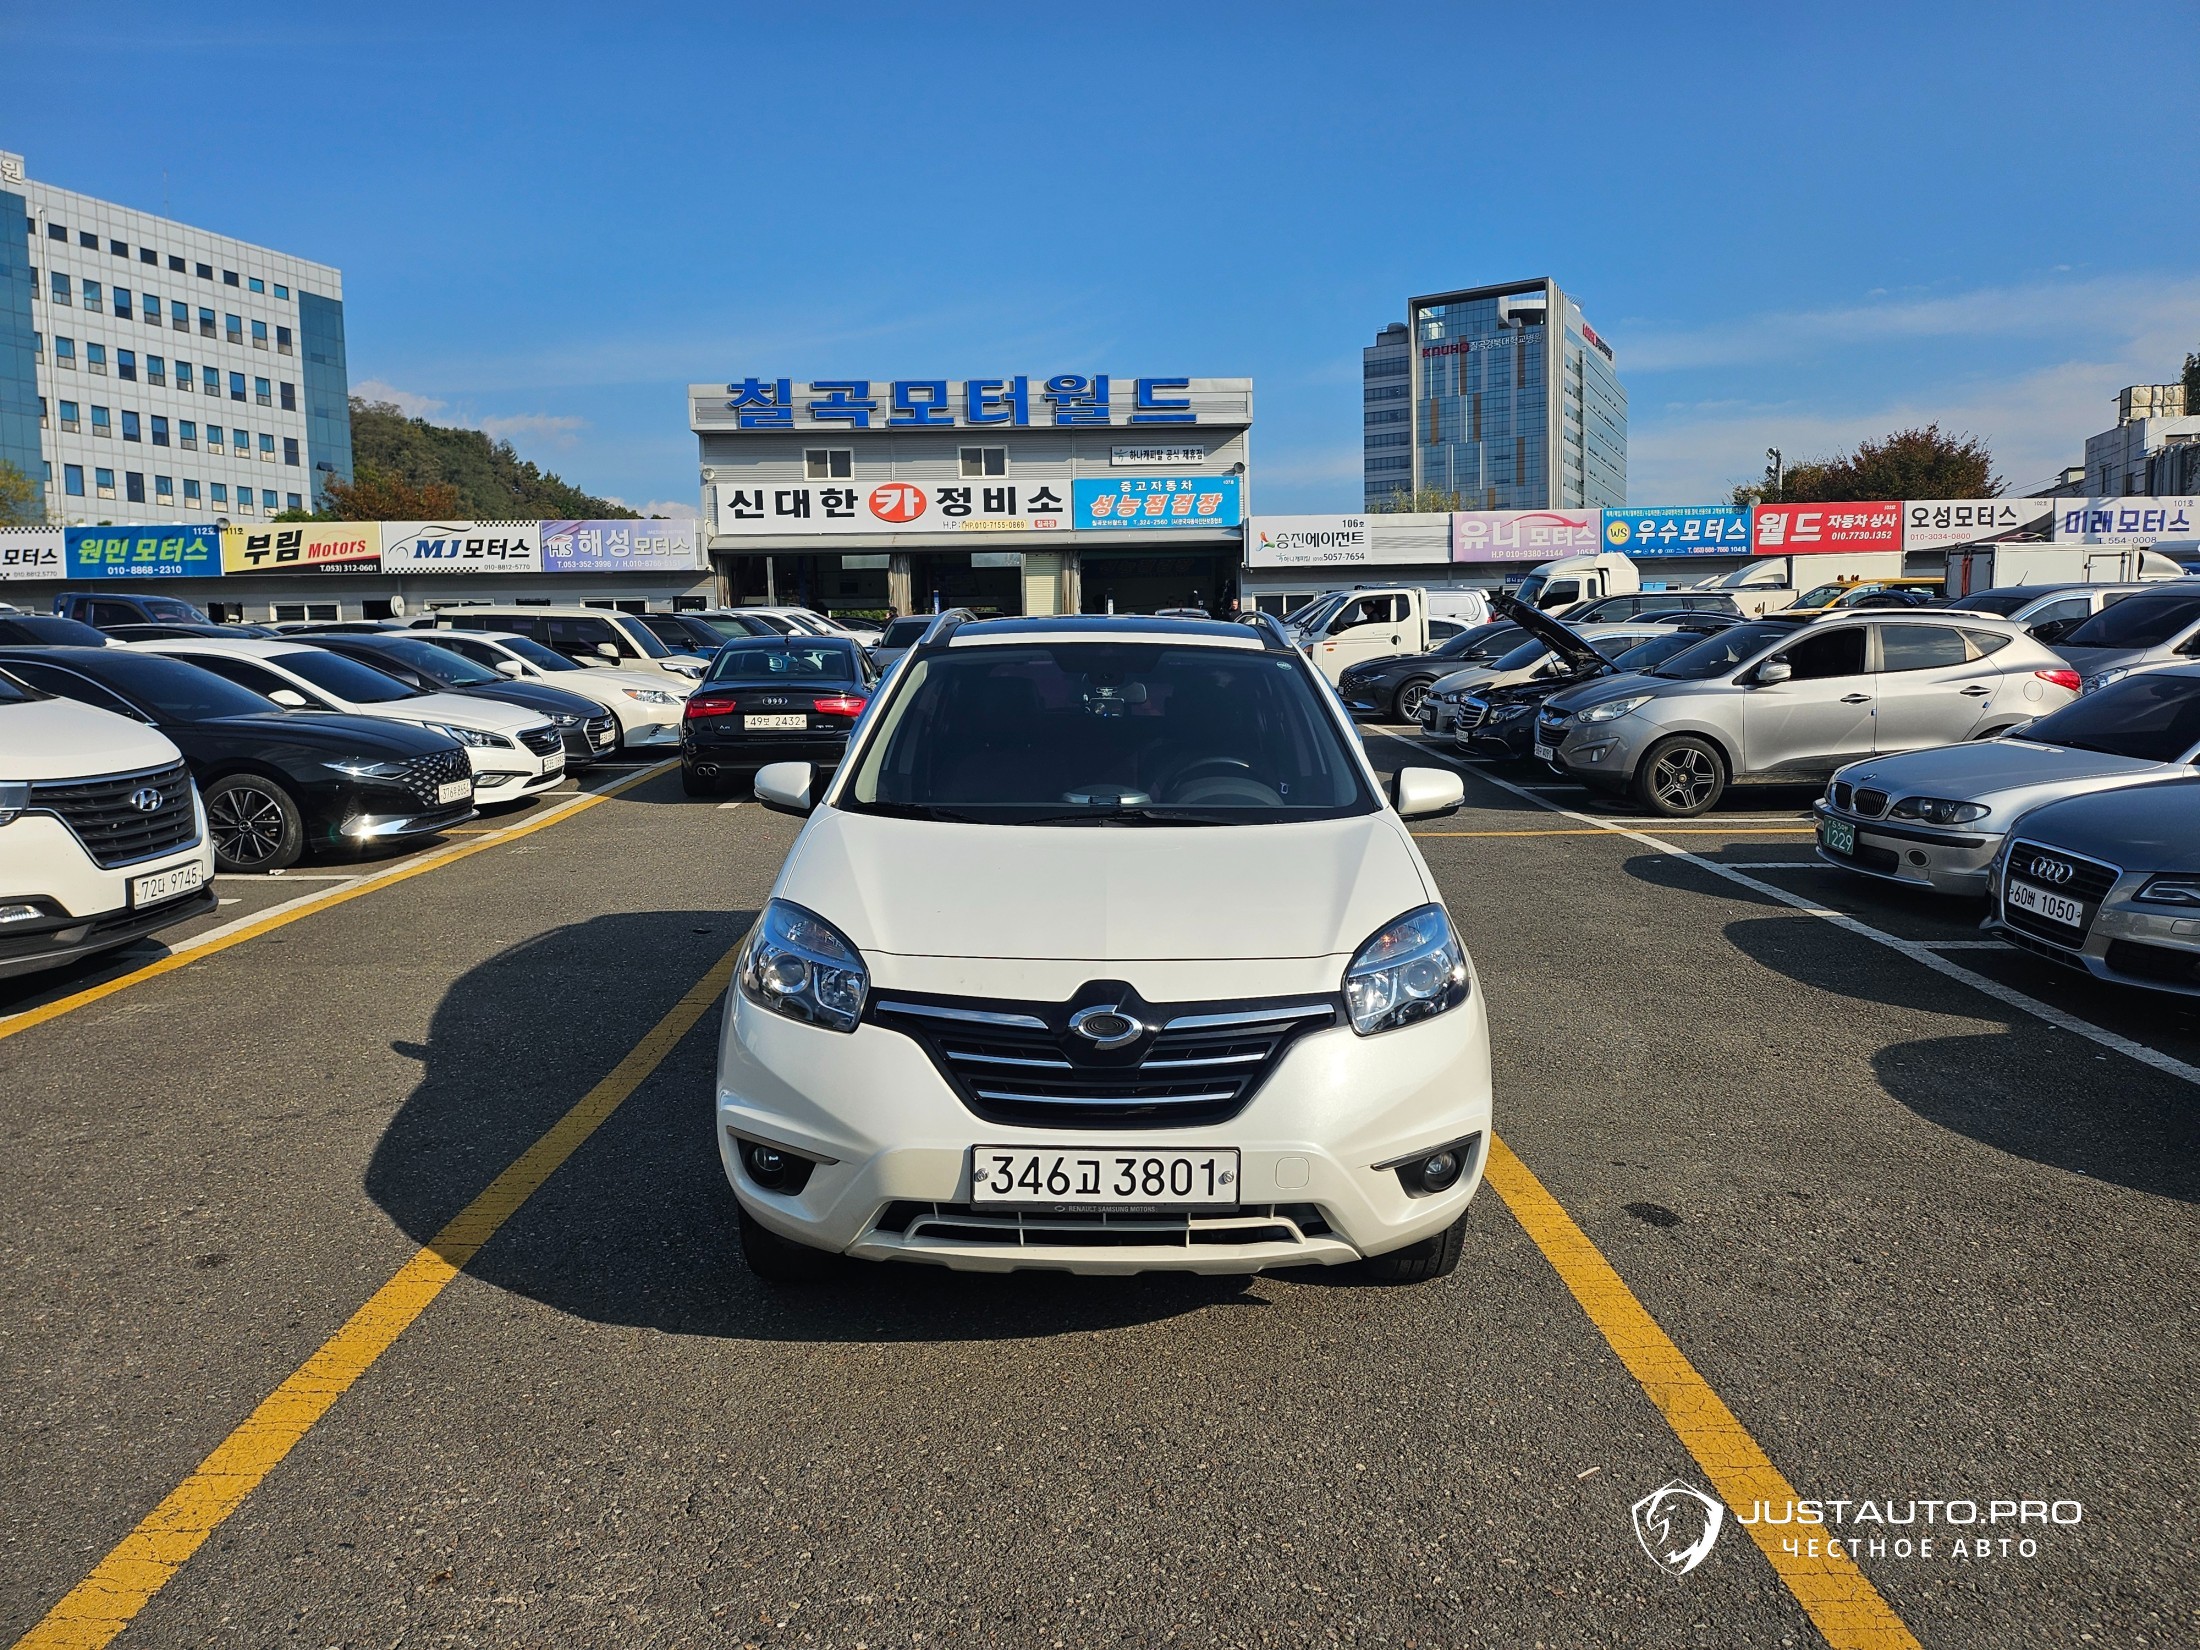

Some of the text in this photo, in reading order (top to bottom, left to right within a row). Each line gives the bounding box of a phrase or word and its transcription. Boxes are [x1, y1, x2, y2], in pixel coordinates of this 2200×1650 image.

[728, 375, 1197, 429] 칠곡모터월드
[1120, 480, 1193, 492] 중고자동차
[1090, 493, 1223, 517] 성능점검장
[1342, 519, 1365, 528] 106호
[1910, 506, 2017, 528] 오성모터스
[193, 527, 216, 536] 112호
[1635, 518, 1747, 545] 우수모터스
[1756, 513, 1897, 546] 월드 자동차 상사
[1831, 530, 1893, 541] 010.7730.1352
[1910, 533, 1971, 541] 010-3034-0800
[2, 549, 58, 566] 모터스
[244, 529, 367, 565] 부림 Motors
[1506, 549, 1564, 558] 010-9380-1144
[107, 565, 182, 575] 010-8868-2310
[775, 716, 801, 726] 2432
[1826, 826, 1853, 852] 1229
[170, 866, 198, 892] 9745
[2042, 894, 2075, 922] 1050
[990, 1156, 1215, 1196] 346고 3801
